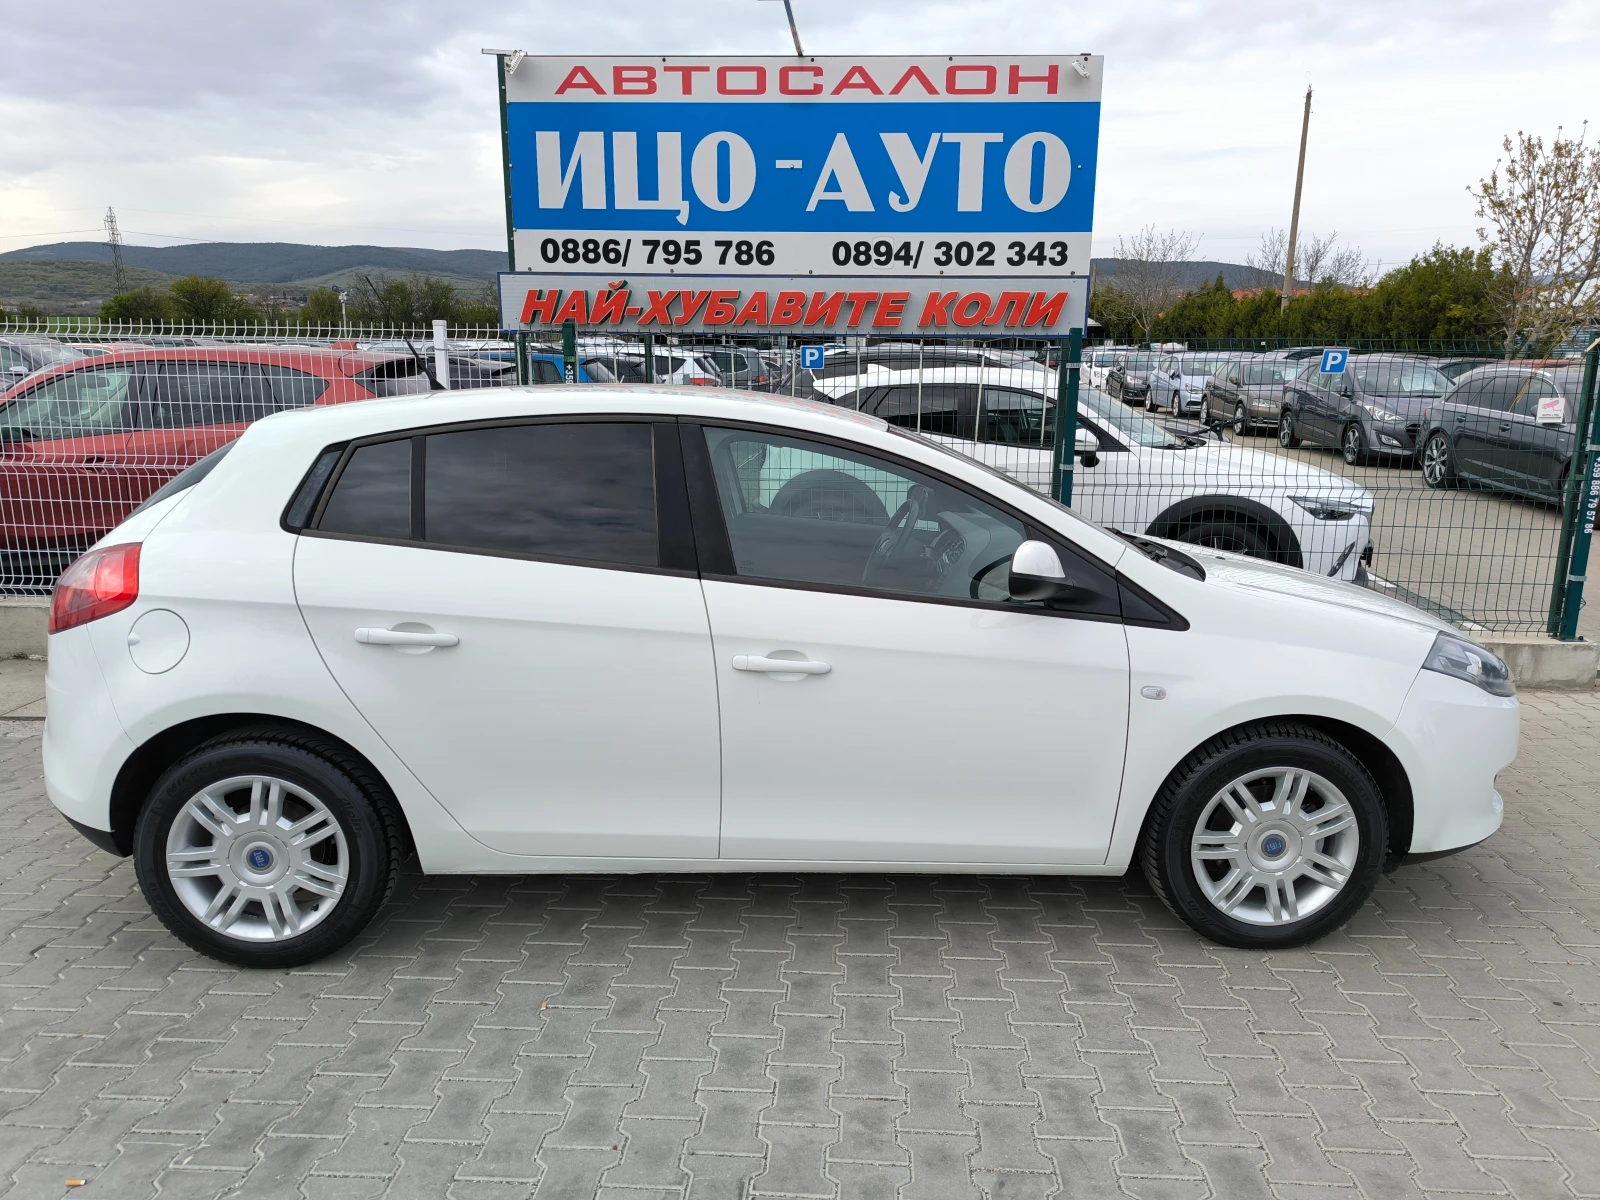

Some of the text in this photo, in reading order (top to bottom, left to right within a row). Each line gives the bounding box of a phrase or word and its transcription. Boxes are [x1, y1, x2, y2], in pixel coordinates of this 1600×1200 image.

[554, 65, 1059, 95] АВТОСАЛОН
[540, 238, 775, 267] 0886/ 795 786
[832, 240, 1068, 268] 0894/ 302 343
[519, 280, 1069, 327] НАЙ-ХУБАВИТЕ КОЛИ
